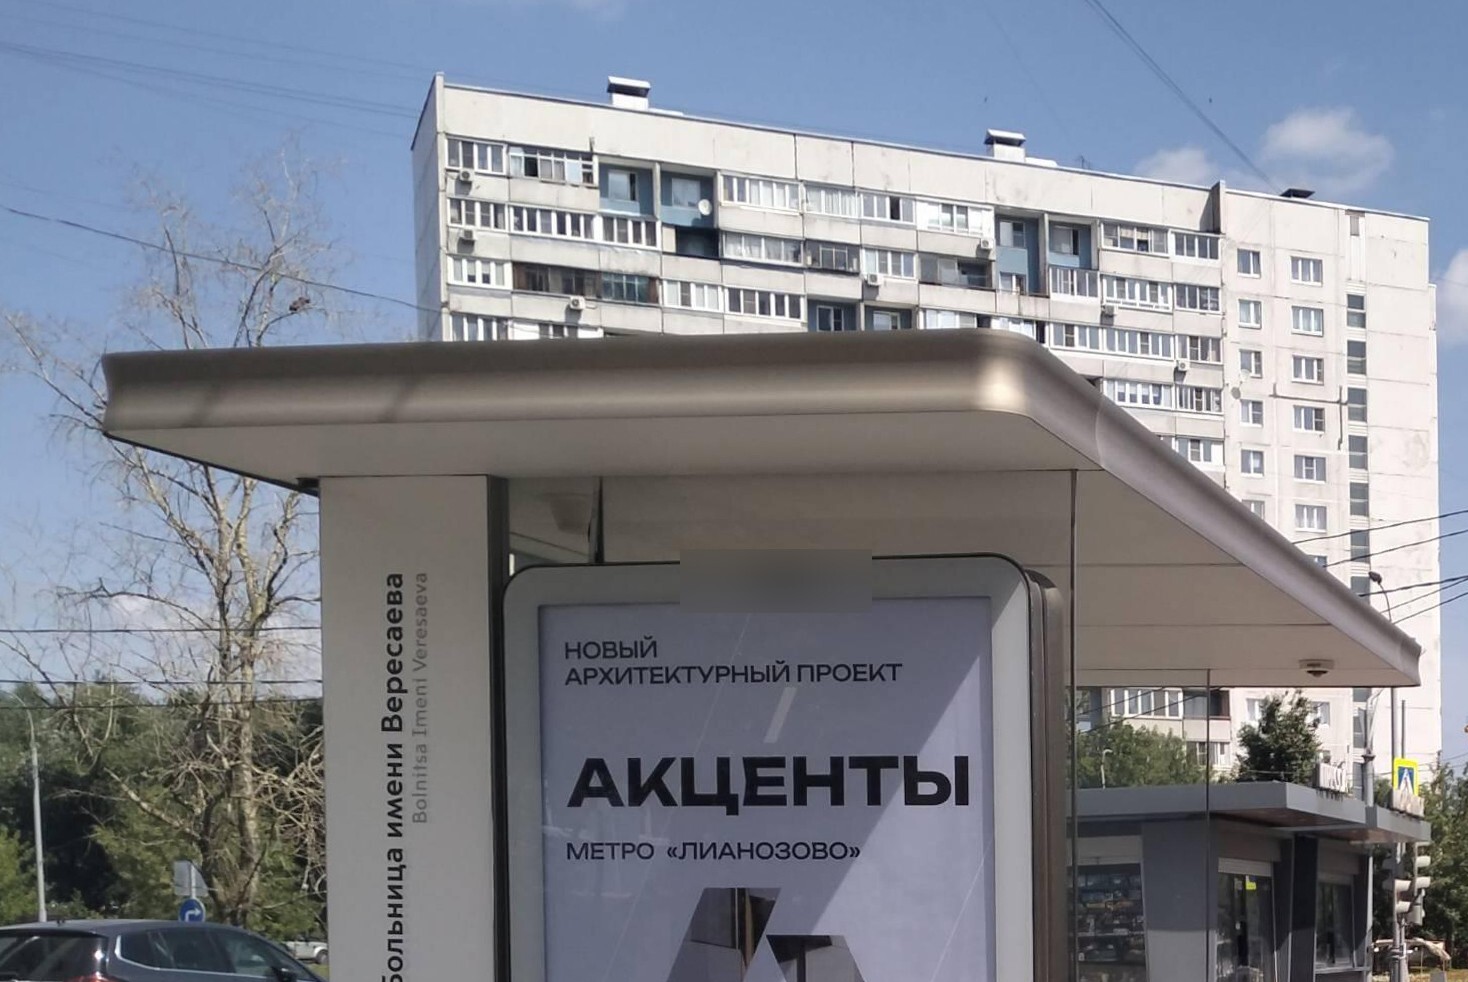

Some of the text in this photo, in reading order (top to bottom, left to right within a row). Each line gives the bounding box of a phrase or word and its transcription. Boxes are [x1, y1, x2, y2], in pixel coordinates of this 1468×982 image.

[381, 573, 408, 732] Вересаева
[564, 636, 658, 660] НОВЫЙ
[565, 660, 903, 686] АРХИТЕКТУРНЫЙ ПРОЕКТ
[412, 572, 428, 824] Bolnitsa Imeni Veresaeva
[386, 743, 403, 838] имени
[566, 755, 969, 816] АКЦЕНТЫ
[565, 842, 861, 861] МЕТРО «ЛИАНОЗОВО»
